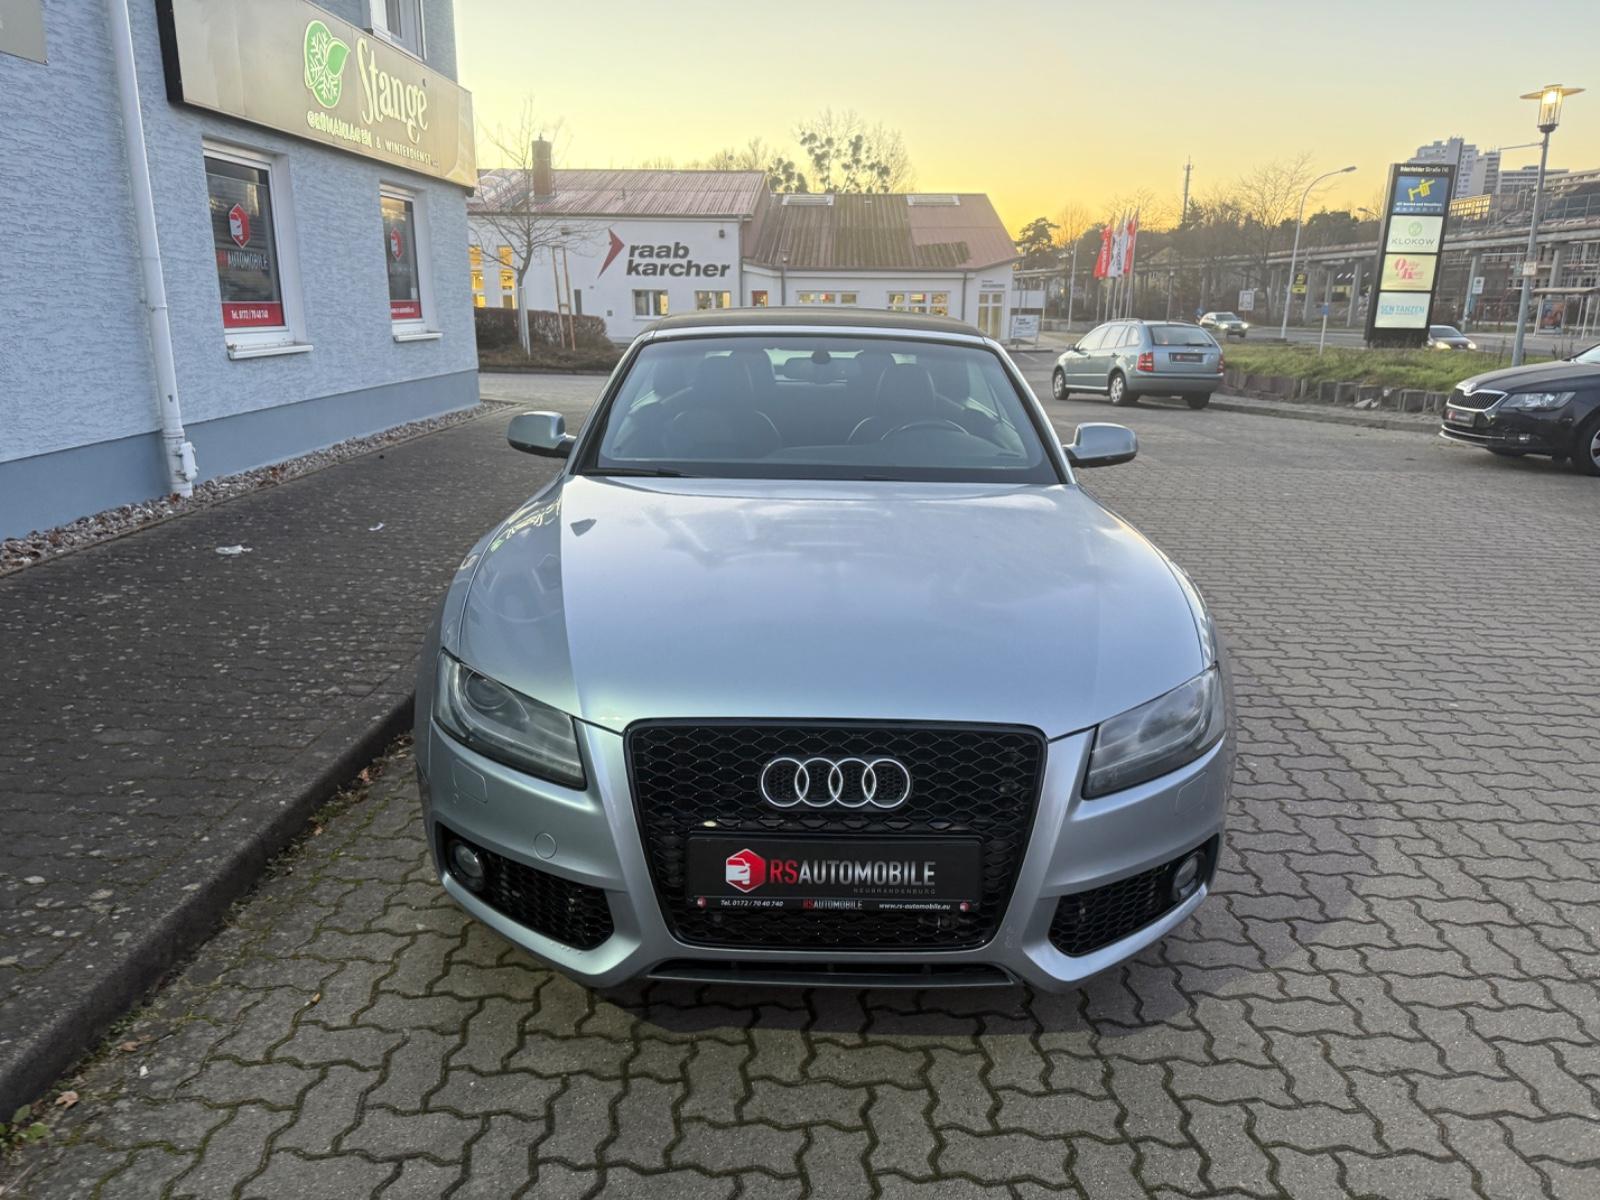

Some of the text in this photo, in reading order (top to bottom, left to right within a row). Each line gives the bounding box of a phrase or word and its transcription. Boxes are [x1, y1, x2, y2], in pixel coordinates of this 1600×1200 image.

[357, 37, 428, 144] Stange
[384, 139, 431, 165] WINTERDIENST
[628, 242, 690, 259] raab
[1391, 238, 1436, 246] KLOKOW
[626, 259, 731, 278] karcher
[769, 860, 936, 886] RSAUTOMOBILE
[879, 902, 951, 910] www.rs-automobile.eu
